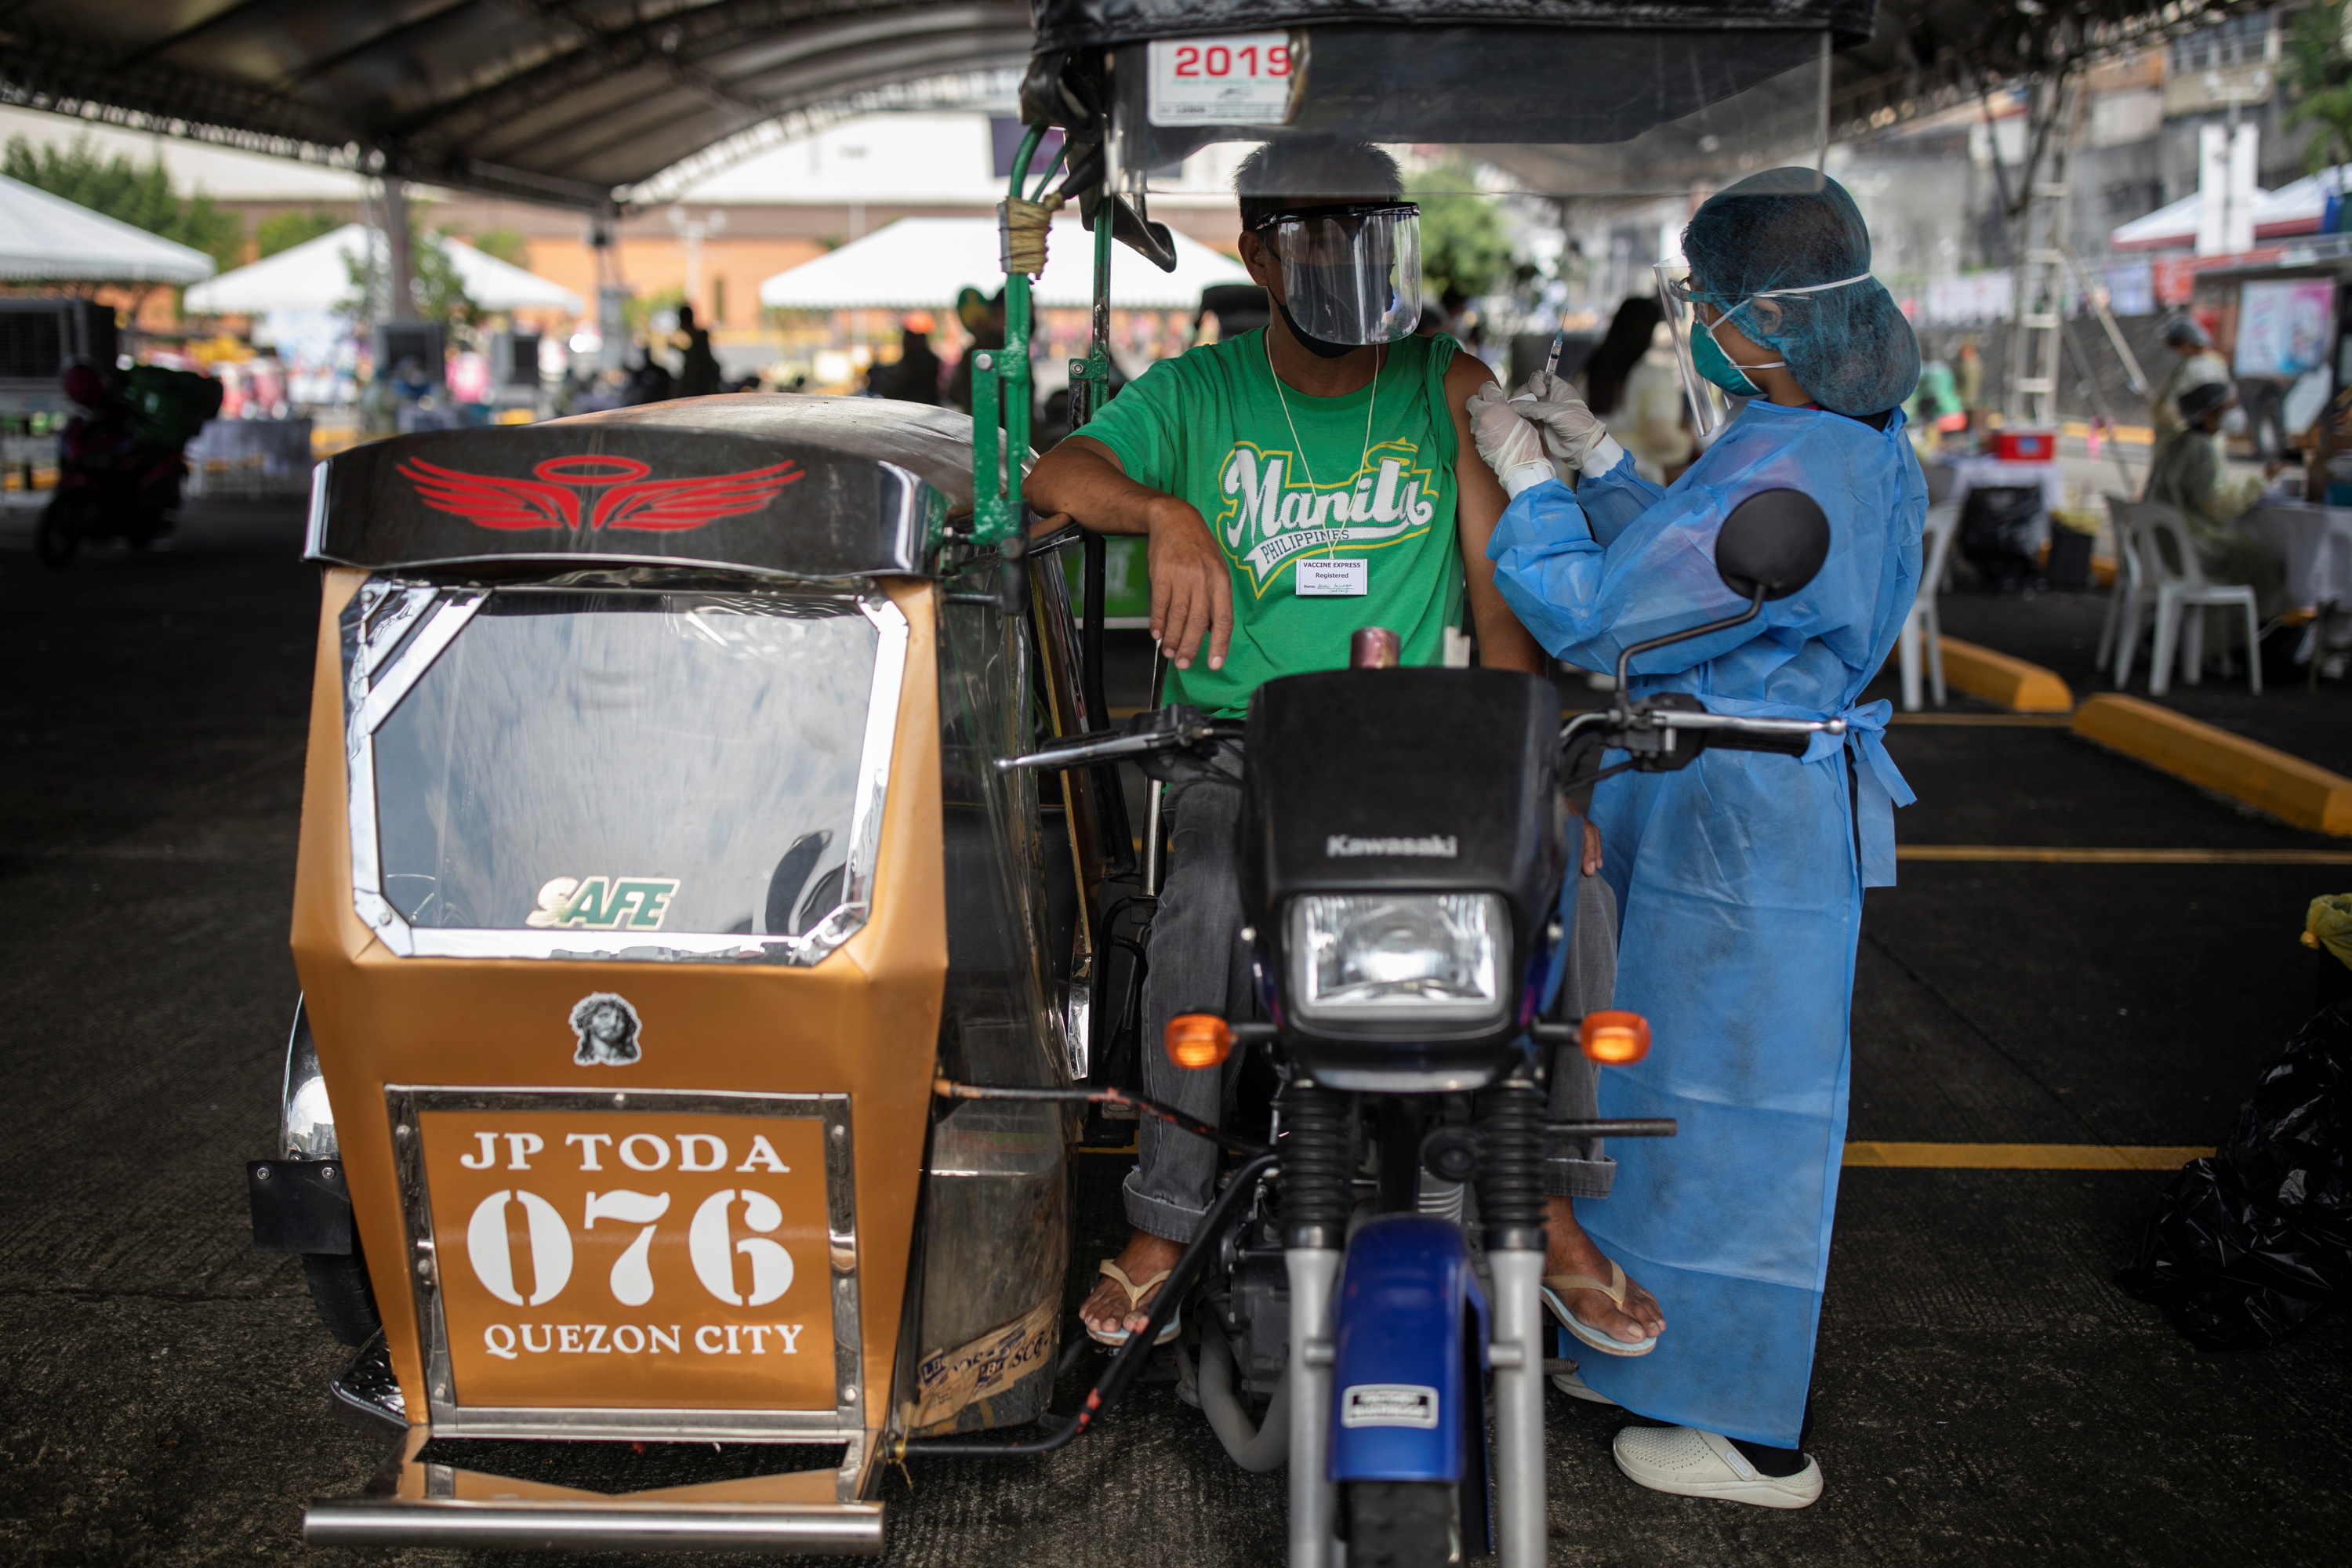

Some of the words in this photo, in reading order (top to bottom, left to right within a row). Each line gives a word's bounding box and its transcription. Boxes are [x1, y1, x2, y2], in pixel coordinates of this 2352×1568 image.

[1174, 45, 1292, 77] 2019
[1224, 448, 1434, 548] Manila
[1260, 529, 1349, 564] PHILIPPINES
[524, 876, 681, 931] SAFE
[459, 1131, 545, 1171] JP
[564, 1132, 791, 1174] TODA
[466, 1189, 795, 1308] 076
[484, 1323, 681, 1359] QUEZON
[695, 1324, 804, 1355] CITY
